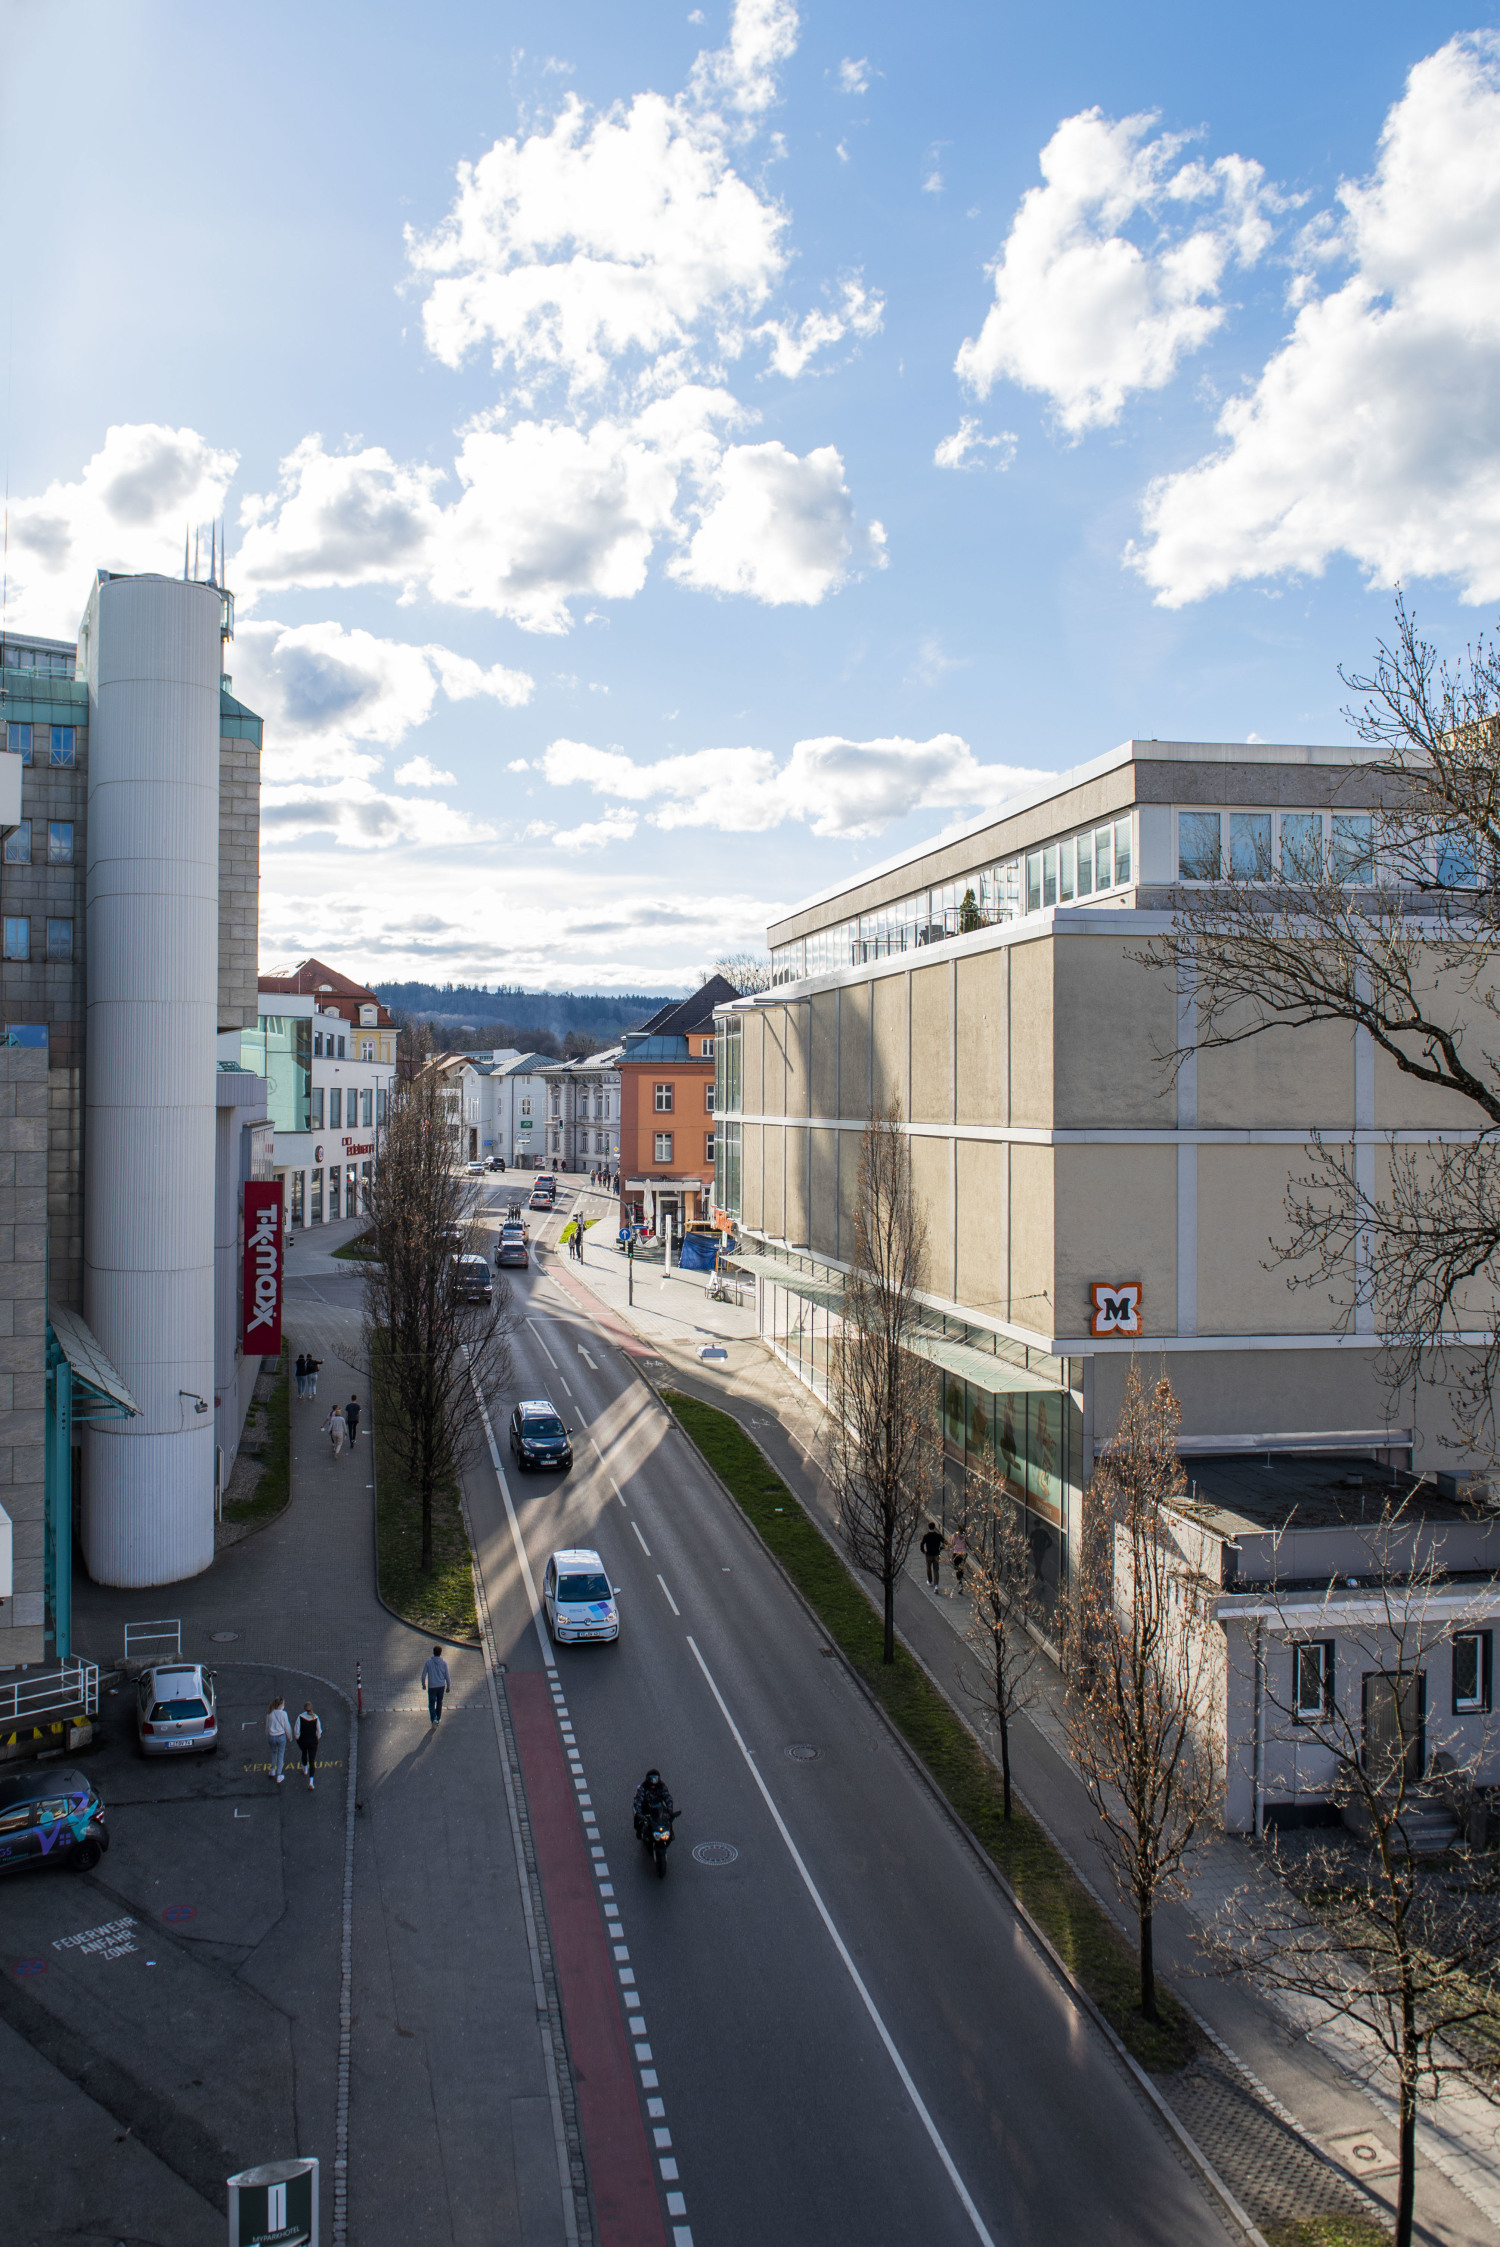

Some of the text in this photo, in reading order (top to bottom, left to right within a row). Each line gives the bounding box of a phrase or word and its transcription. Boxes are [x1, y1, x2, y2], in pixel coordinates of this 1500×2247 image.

[1103, 1297, 1131, 1321] M
[243, 1760, 343, 1773] VERALUNG
[51, 1916, 138, 1951] FEUERWEHR
[80, 1929, 137, 1955] ANFAHR
[99, 1941, 139, 1960] ZONE
[252, 2225, 300, 2243] MYPARKHOTEL
